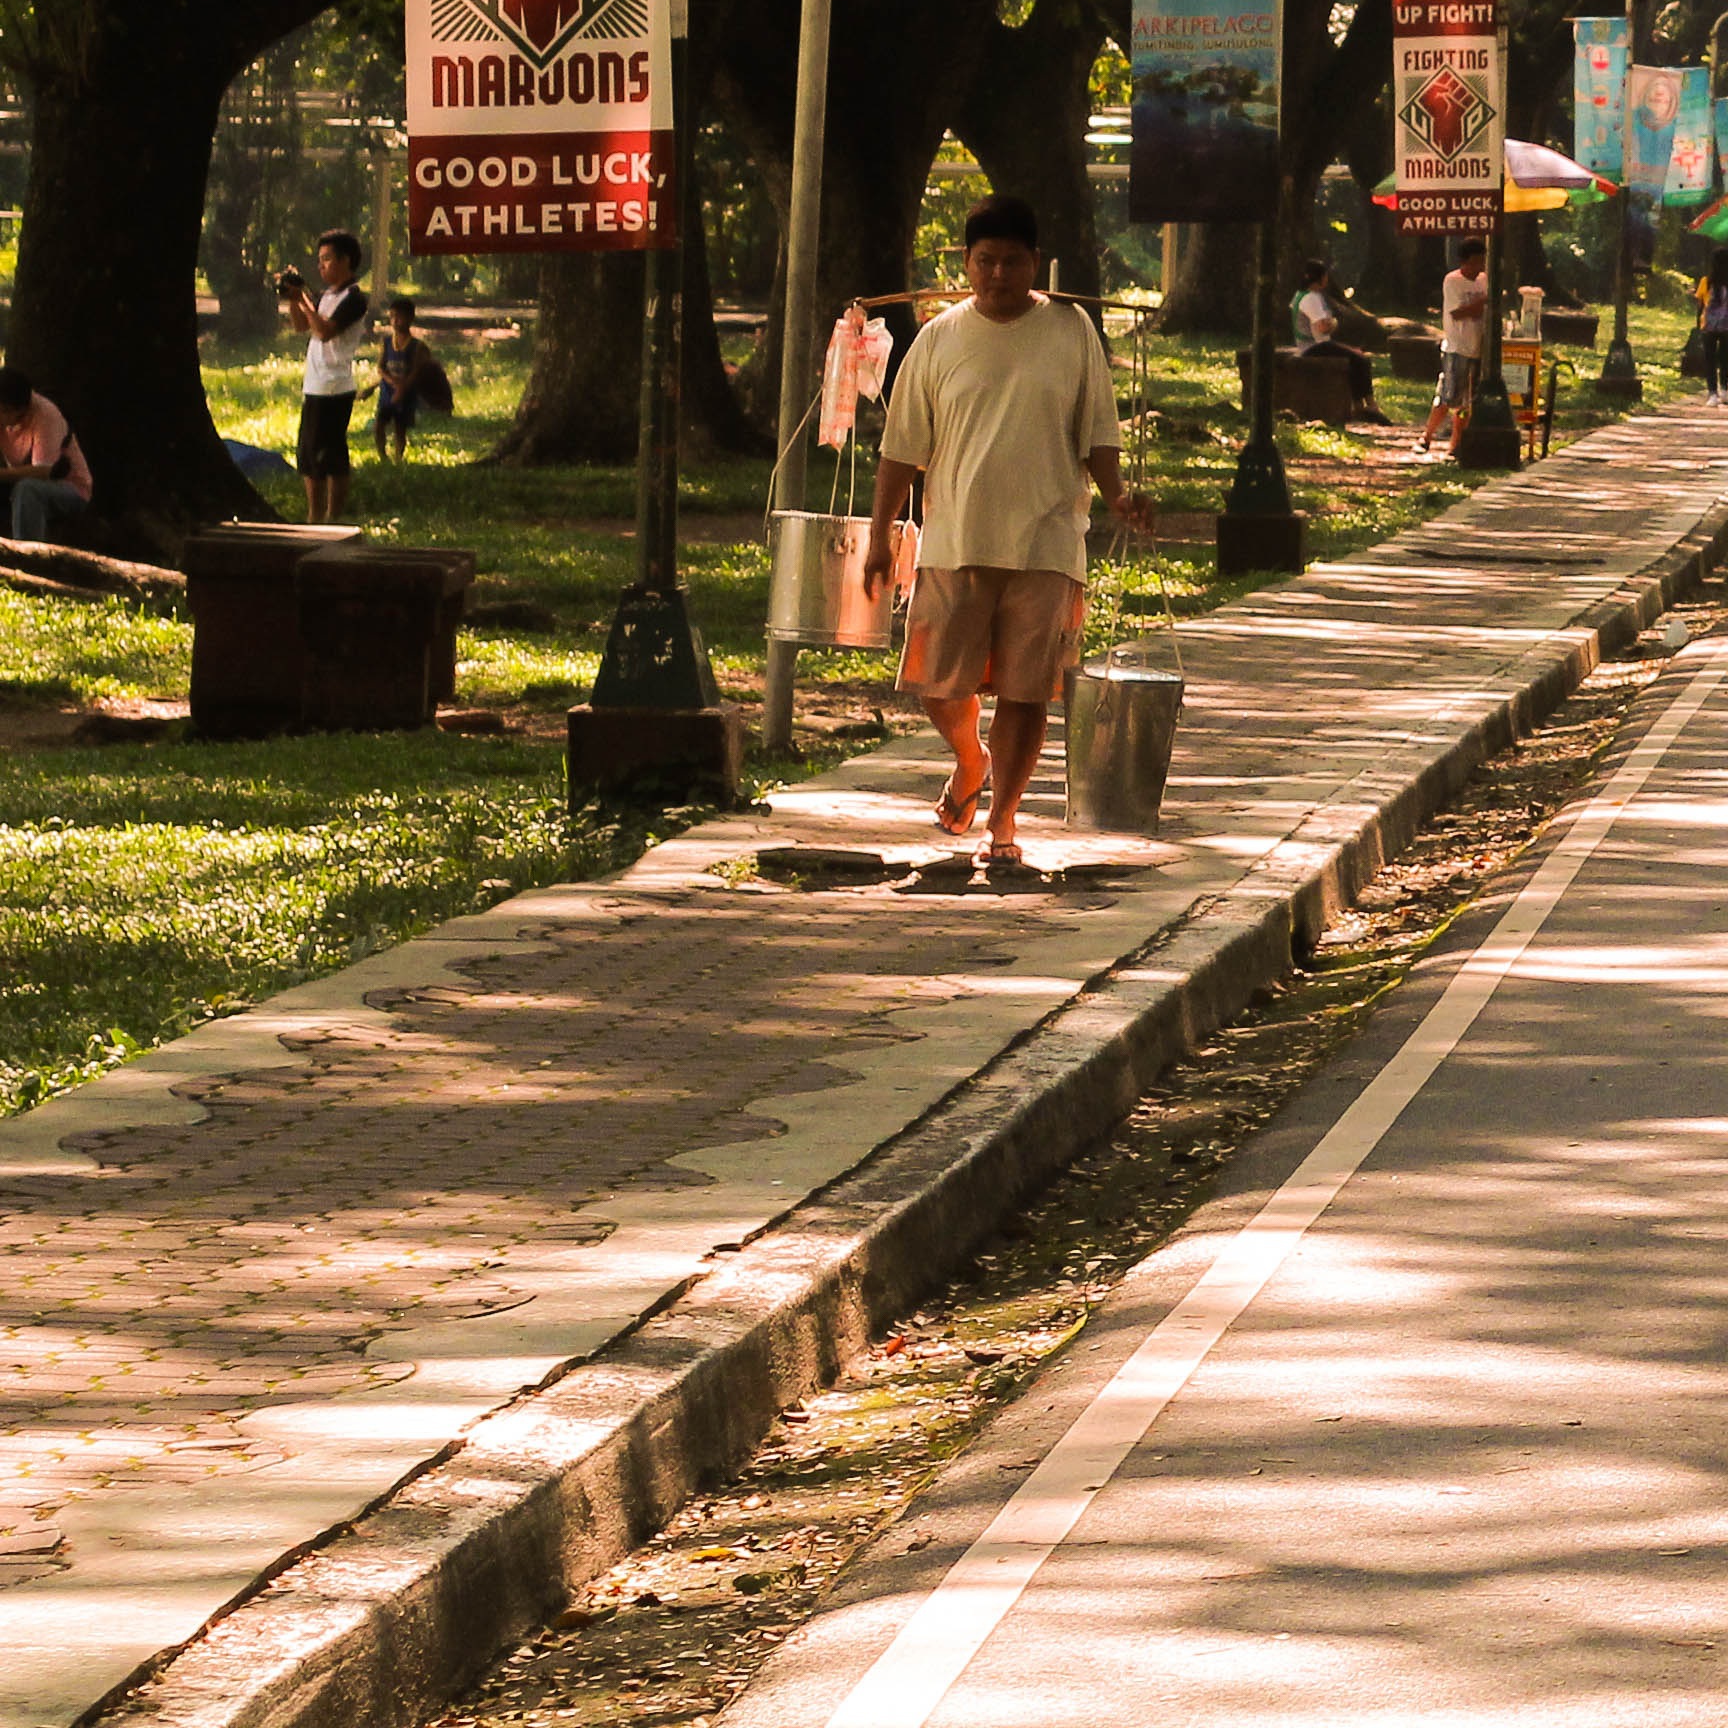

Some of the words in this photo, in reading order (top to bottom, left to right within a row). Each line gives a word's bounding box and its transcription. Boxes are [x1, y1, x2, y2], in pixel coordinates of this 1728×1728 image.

[1397, 5, 1423, 25] UP
[1428, 4, 1493, 24] FIGHT!
[1403, 49, 1488, 71] FIGHTING
[431, 51, 650, 109] MAROONS
[416, 156, 538, 188] GOOD
[552, 153, 667, 191] LUCK,
[1405, 158, 1491, 179] MAROONS
[1399, 198, 1447, 211] GOOD
[1451, 197, 1498, 211] LUCK,
[426, 201, 658, 236] ATHLETES!
[1402, 215, 1494, 230] ATHLETES!
